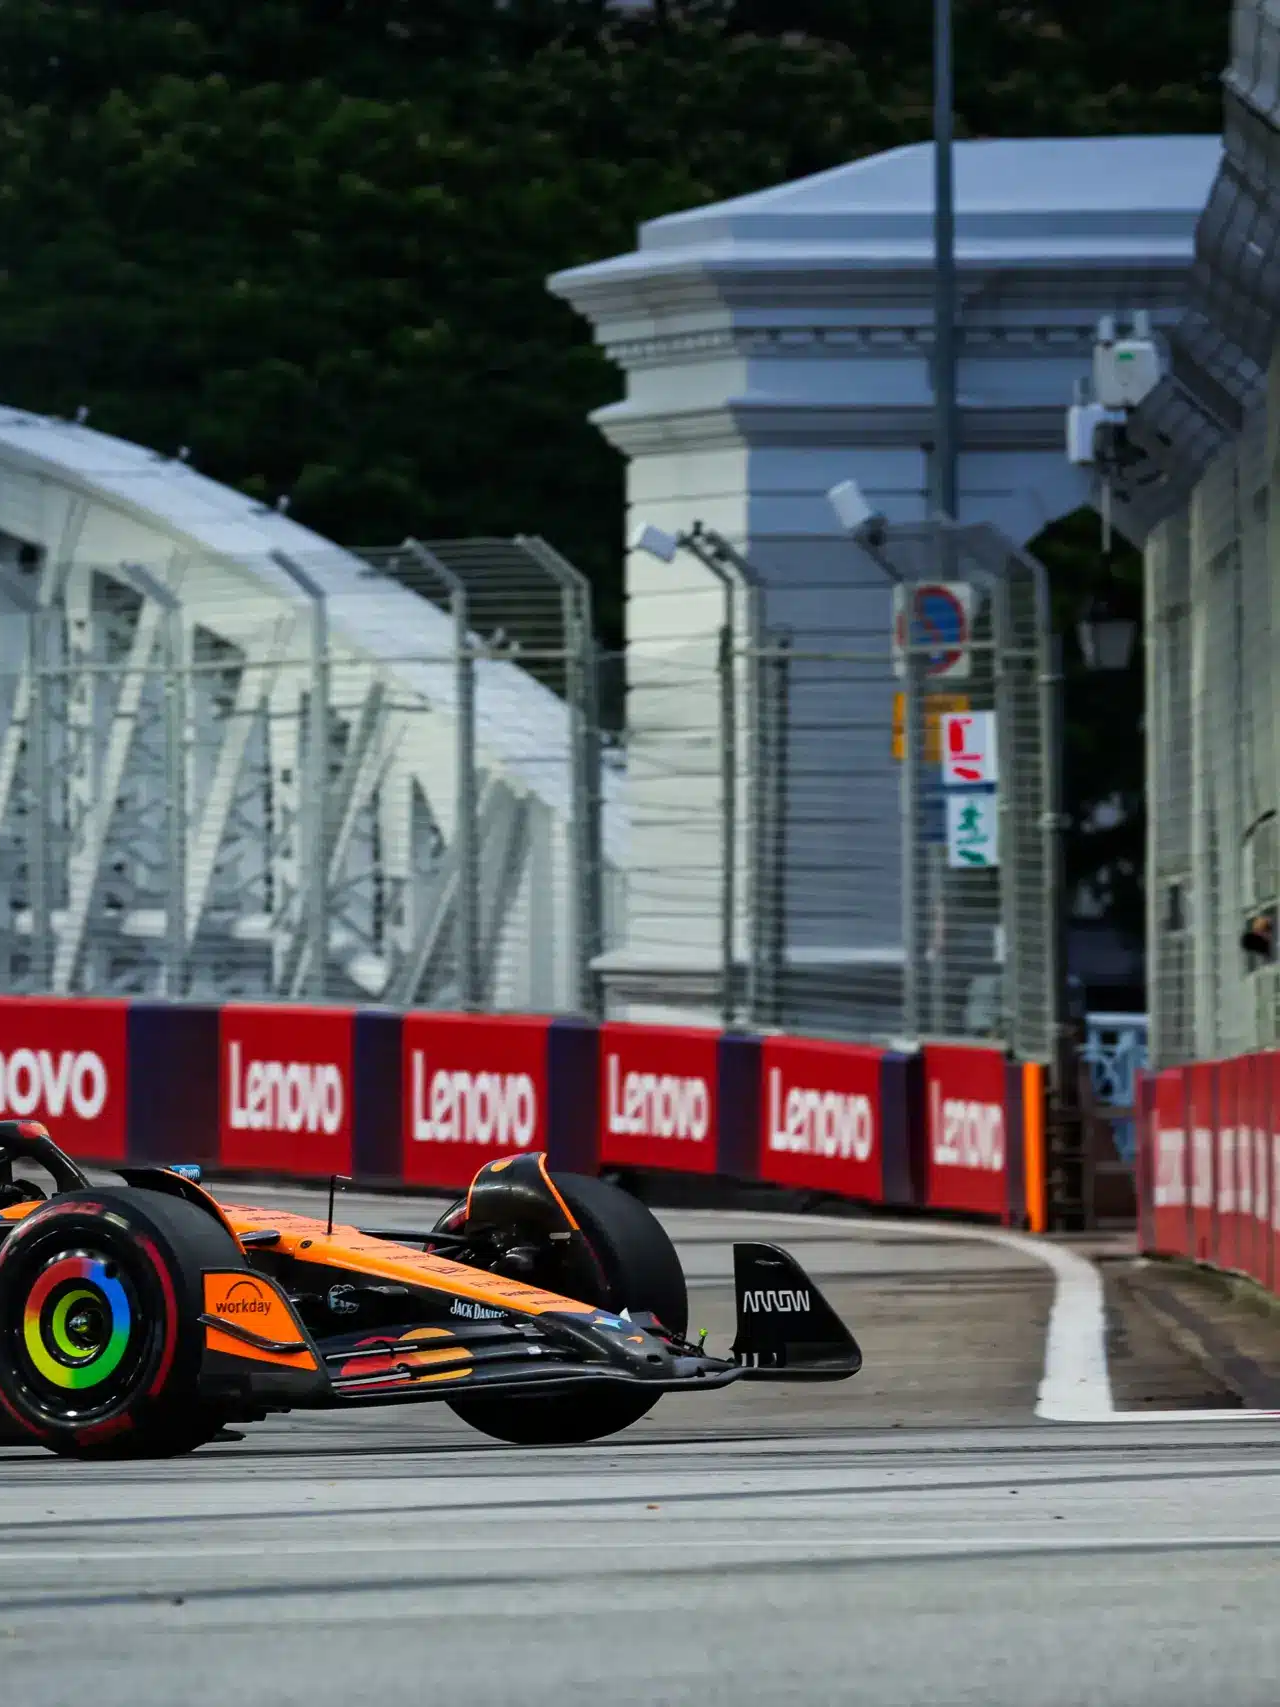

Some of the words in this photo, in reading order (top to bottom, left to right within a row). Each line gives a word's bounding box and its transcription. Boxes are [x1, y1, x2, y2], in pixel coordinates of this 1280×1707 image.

[229, 1041, 343, 1135] Lenovo
[411, 1050, 538, 1144] Lenovo
[607, 1054, 710, 1142] Lenovo
[767, 1067, 874, 1163] Lenovo
[931, 1081, 1005, 1173] Lenovo
[215, 1298, 273, 1316] workday
[450, 1298, 474, 1318] JACK
[743, 1289, 811, 1313] ARROW
